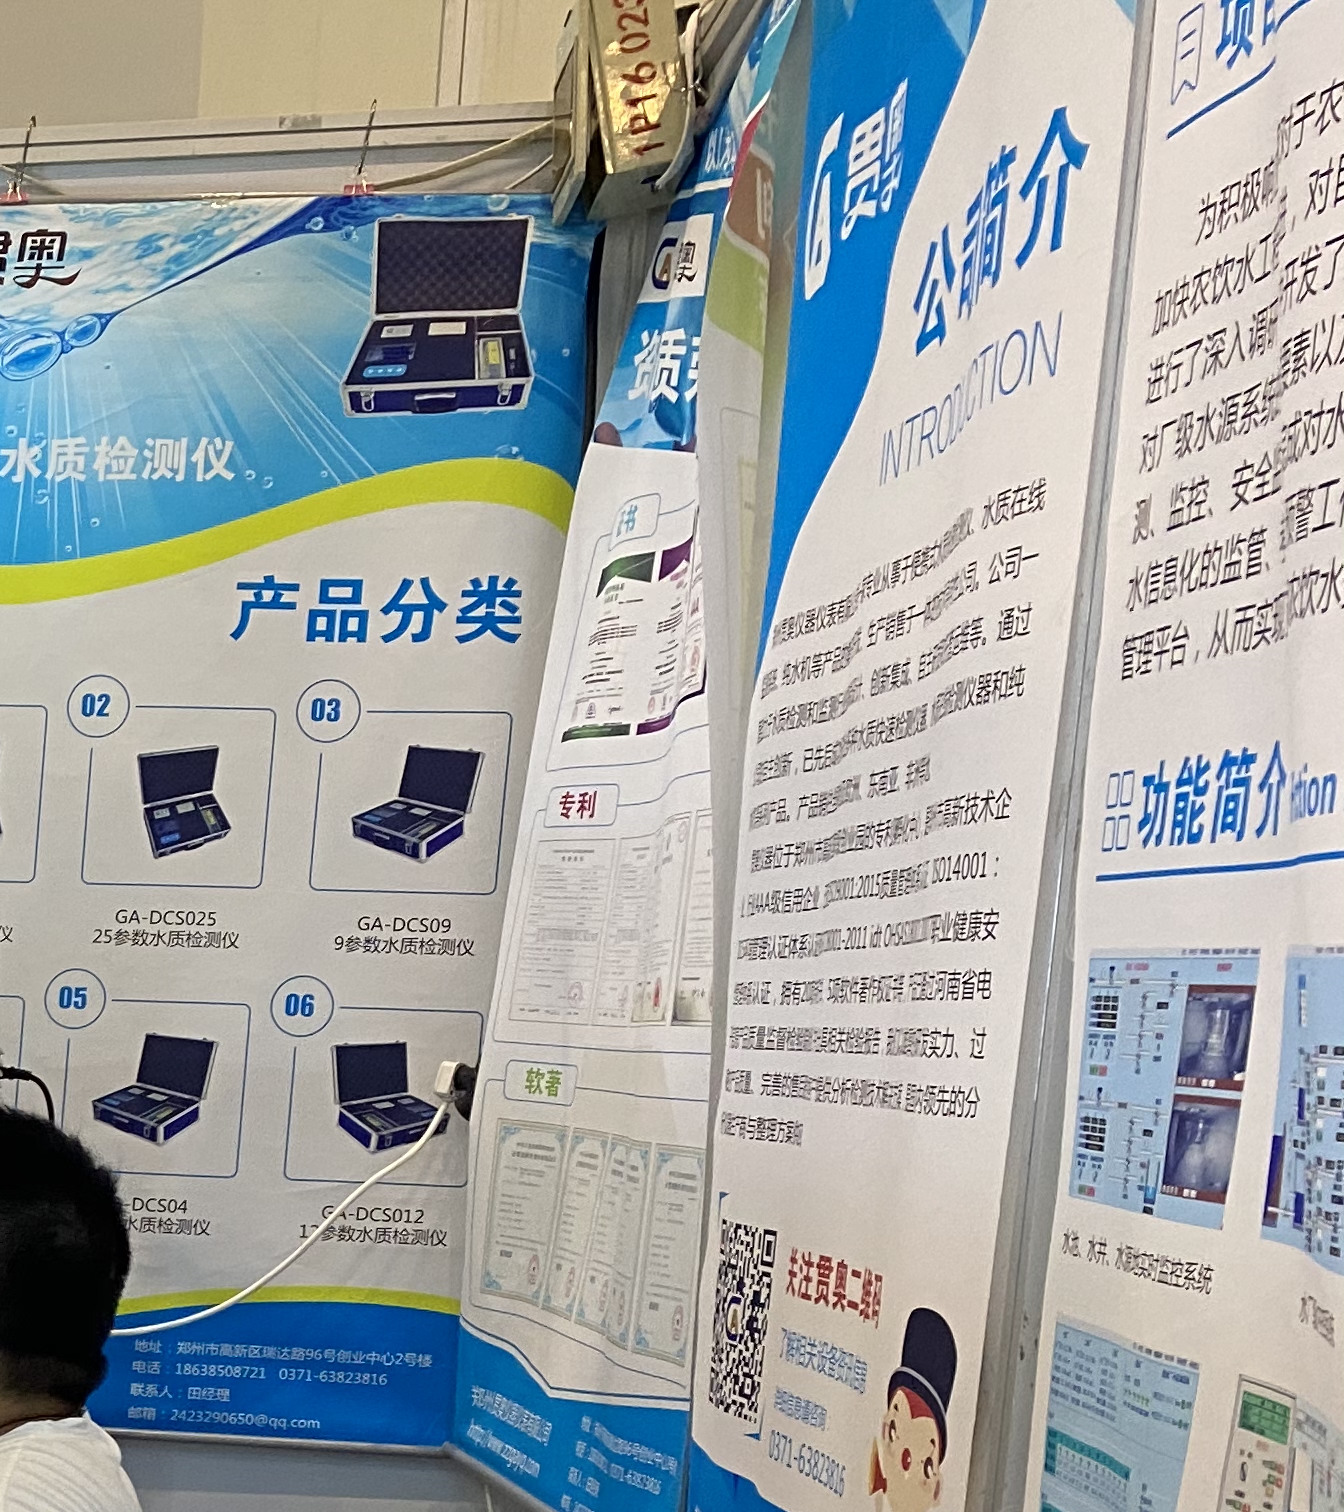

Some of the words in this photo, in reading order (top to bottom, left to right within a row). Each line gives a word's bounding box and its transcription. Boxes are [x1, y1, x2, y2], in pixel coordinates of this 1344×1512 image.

[229, 572, 524, 645] 产品分类
[81, 693, 111, 718] 02
[311, 698, 342, 723] 03
[559, 789, 597, 820] 专利
[1138, 740, 1288, 849] 功能简介
[115, 908, 218, 928] GA-DCS025
[357, 914, 452, 934] GA-DCS09
[92, 927, 240, 950] 25参数水质检测仪
[334, 934, 475, 958] 9参数水质检测仪
[58, 985, 88, 1010] 05
[284, 993, 315, 1018] 06
[524, 1065, 563, 1098] 软著
[278, 1367, 389, 1387] 0371-63823816
